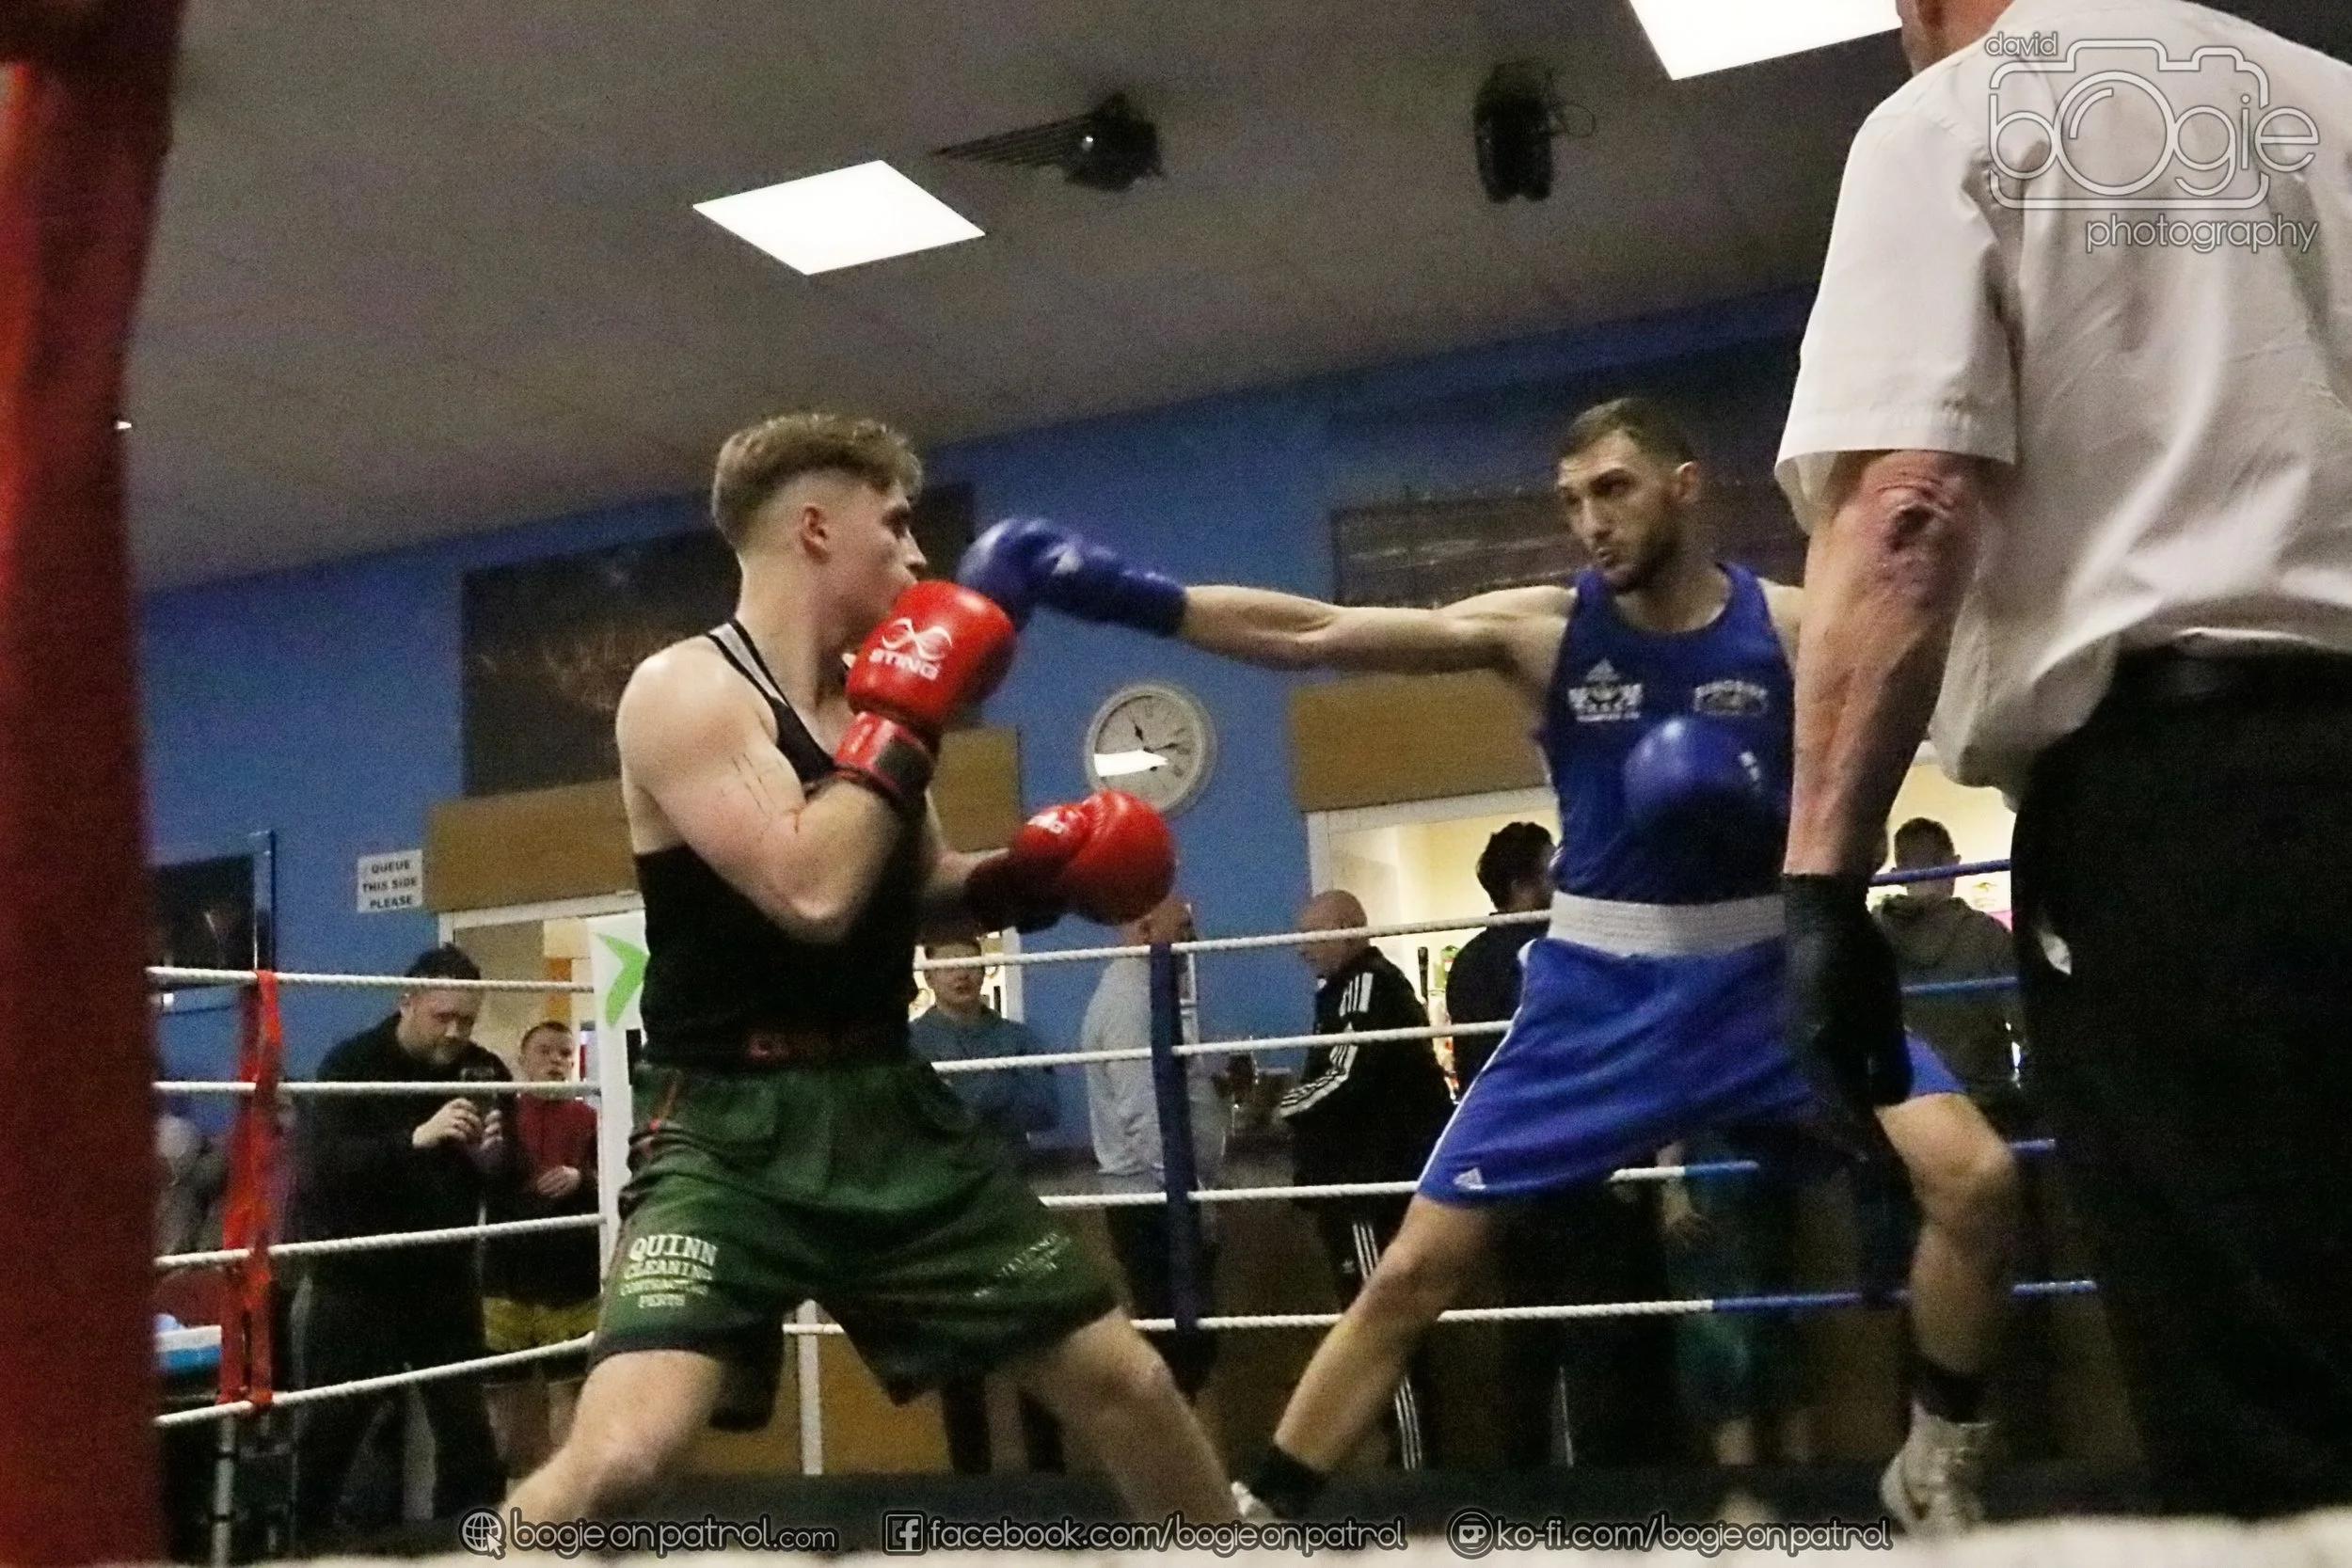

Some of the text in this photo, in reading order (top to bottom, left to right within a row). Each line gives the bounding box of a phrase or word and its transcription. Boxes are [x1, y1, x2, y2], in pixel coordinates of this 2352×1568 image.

[372, 860, 410, 874] QUEUE
[362, 877, 417, 893] THIS SIDE
[370, 895, 411, 909] PLEASE
[629, 1233, 718, 1266] QUINN
